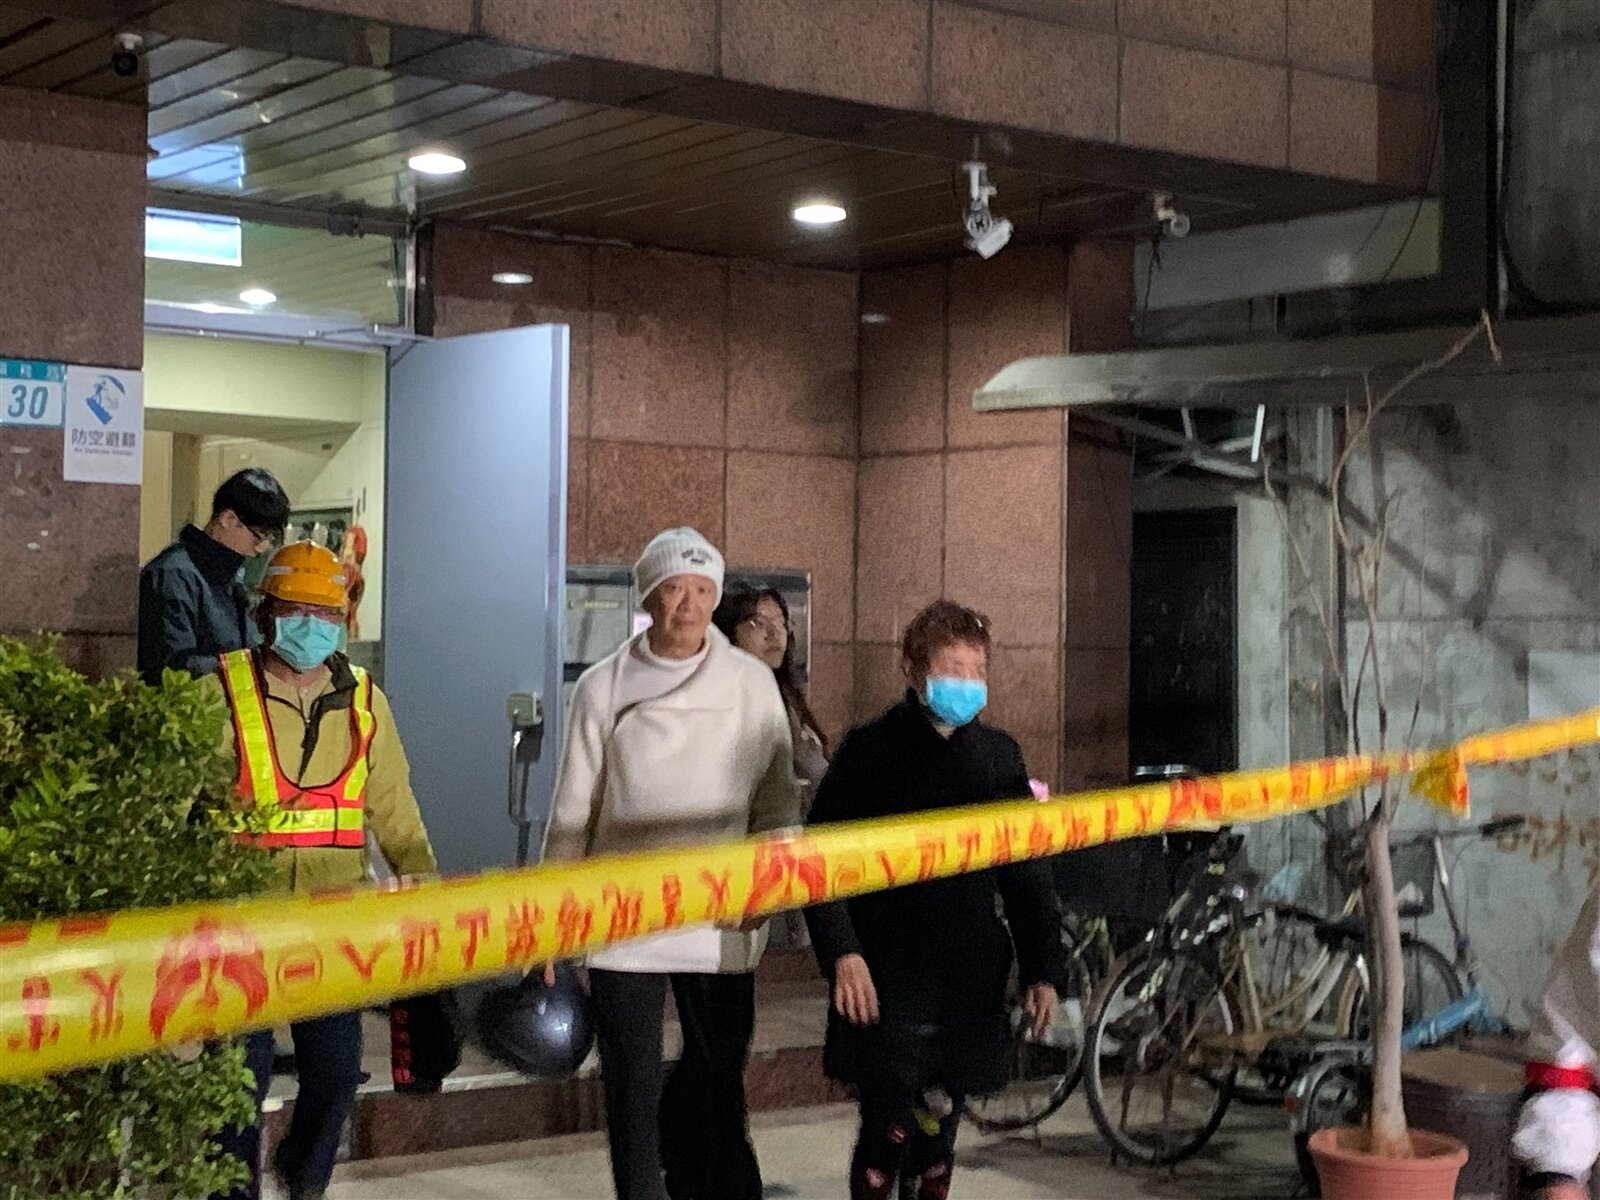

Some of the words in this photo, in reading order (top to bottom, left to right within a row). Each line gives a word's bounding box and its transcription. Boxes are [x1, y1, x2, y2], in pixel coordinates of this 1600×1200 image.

[8, 384, 49, 419] 30
[71, 428, 137, 448] 防空避難
